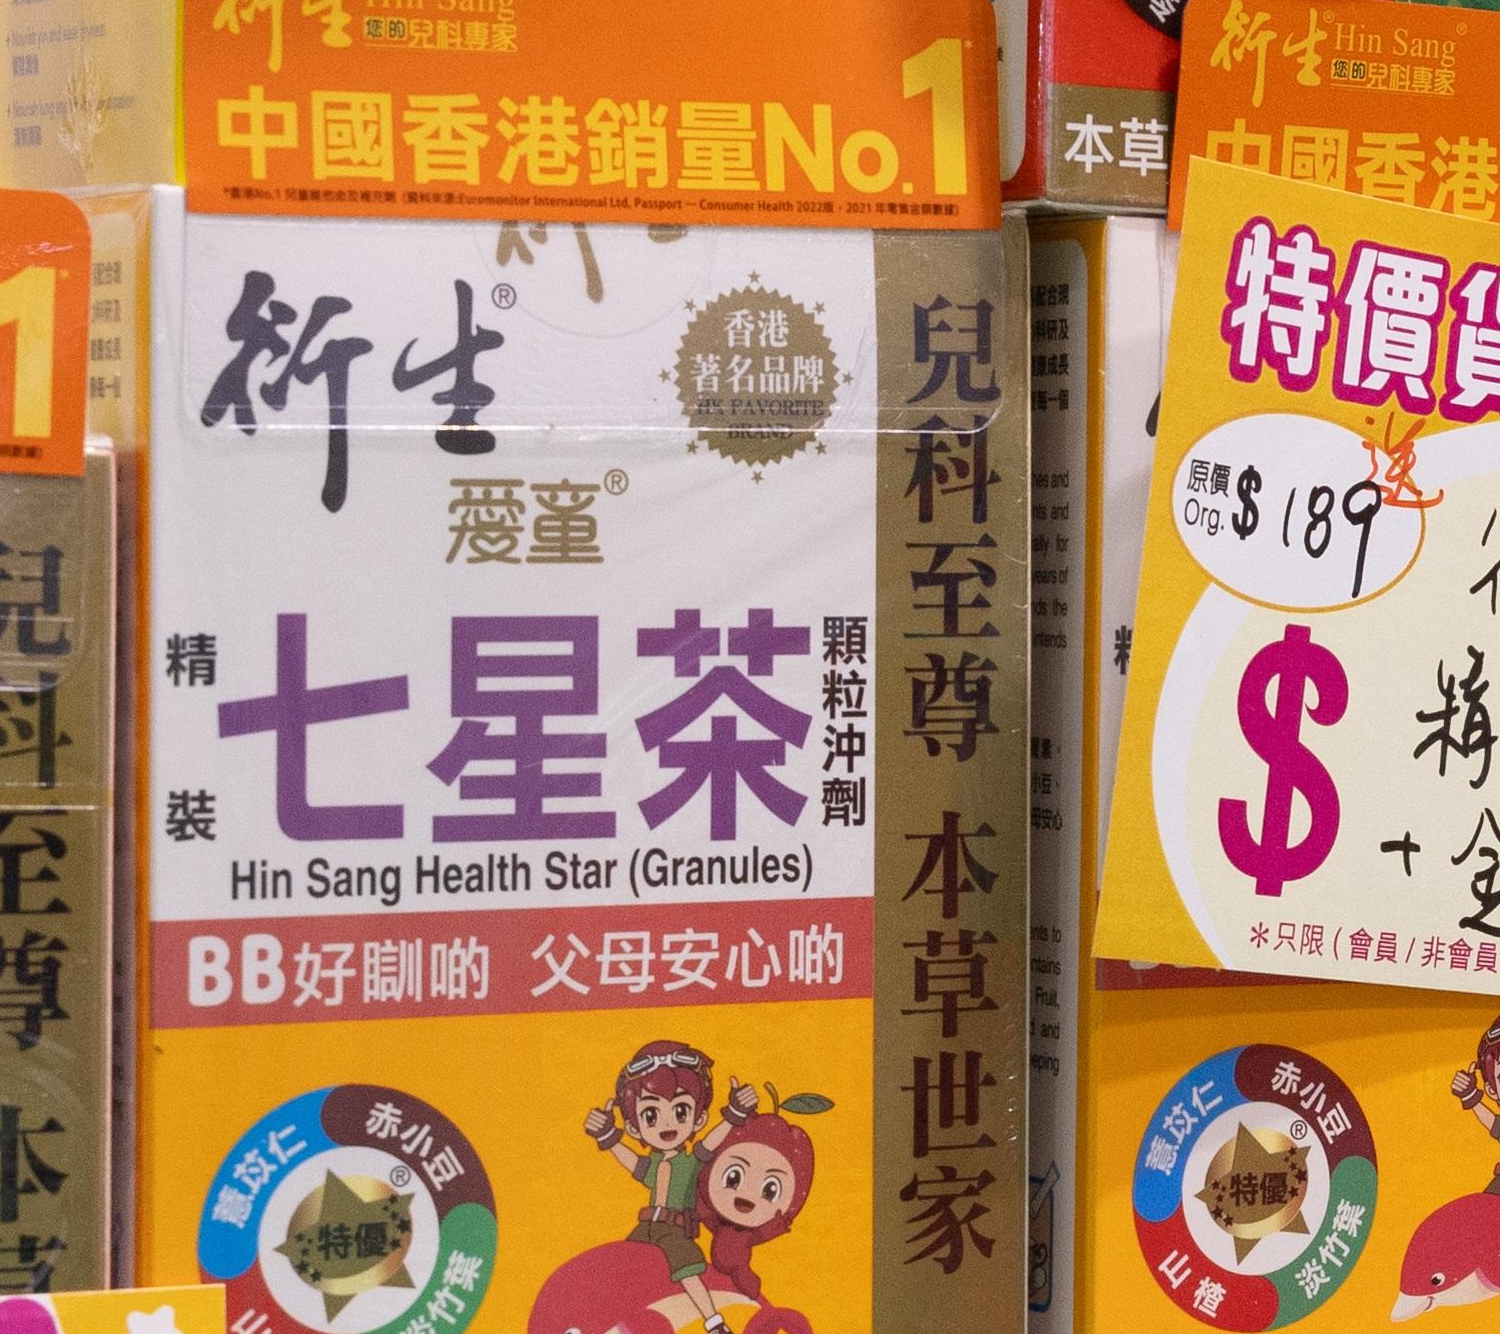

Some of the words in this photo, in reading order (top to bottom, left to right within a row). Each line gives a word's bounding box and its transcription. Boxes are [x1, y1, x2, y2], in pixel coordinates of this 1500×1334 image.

[1333, 20, 1385, 54] Hin
[1392, 28, 1457, 66] Sang
[1331, 59, 1456, 96] 您的兒科專家
[216, 36, 969, 197] 中國香港銷量No.1
[722, 309, 790, 346] 香港
[689, 350, 825, 395] 著名品牌
[1188, 459, 1231, 498] 原價
[216, 607, 815, 845] 七星茶
[229, 861, 294, 902] Hin
[307, 858, 403, 907] Sang
[414, 851, 534, 896] Health
[544, 849, 620, 893] Star
[627, 843, 816, 894] (Granules)
[186, 931, 491, 1011] BB好瞓啲
[530, 922, 845, 1000] 父母安心啲
[1227, 1169, 1290, 1207] 特優
[316, 1222, 389, 1261] 特優
